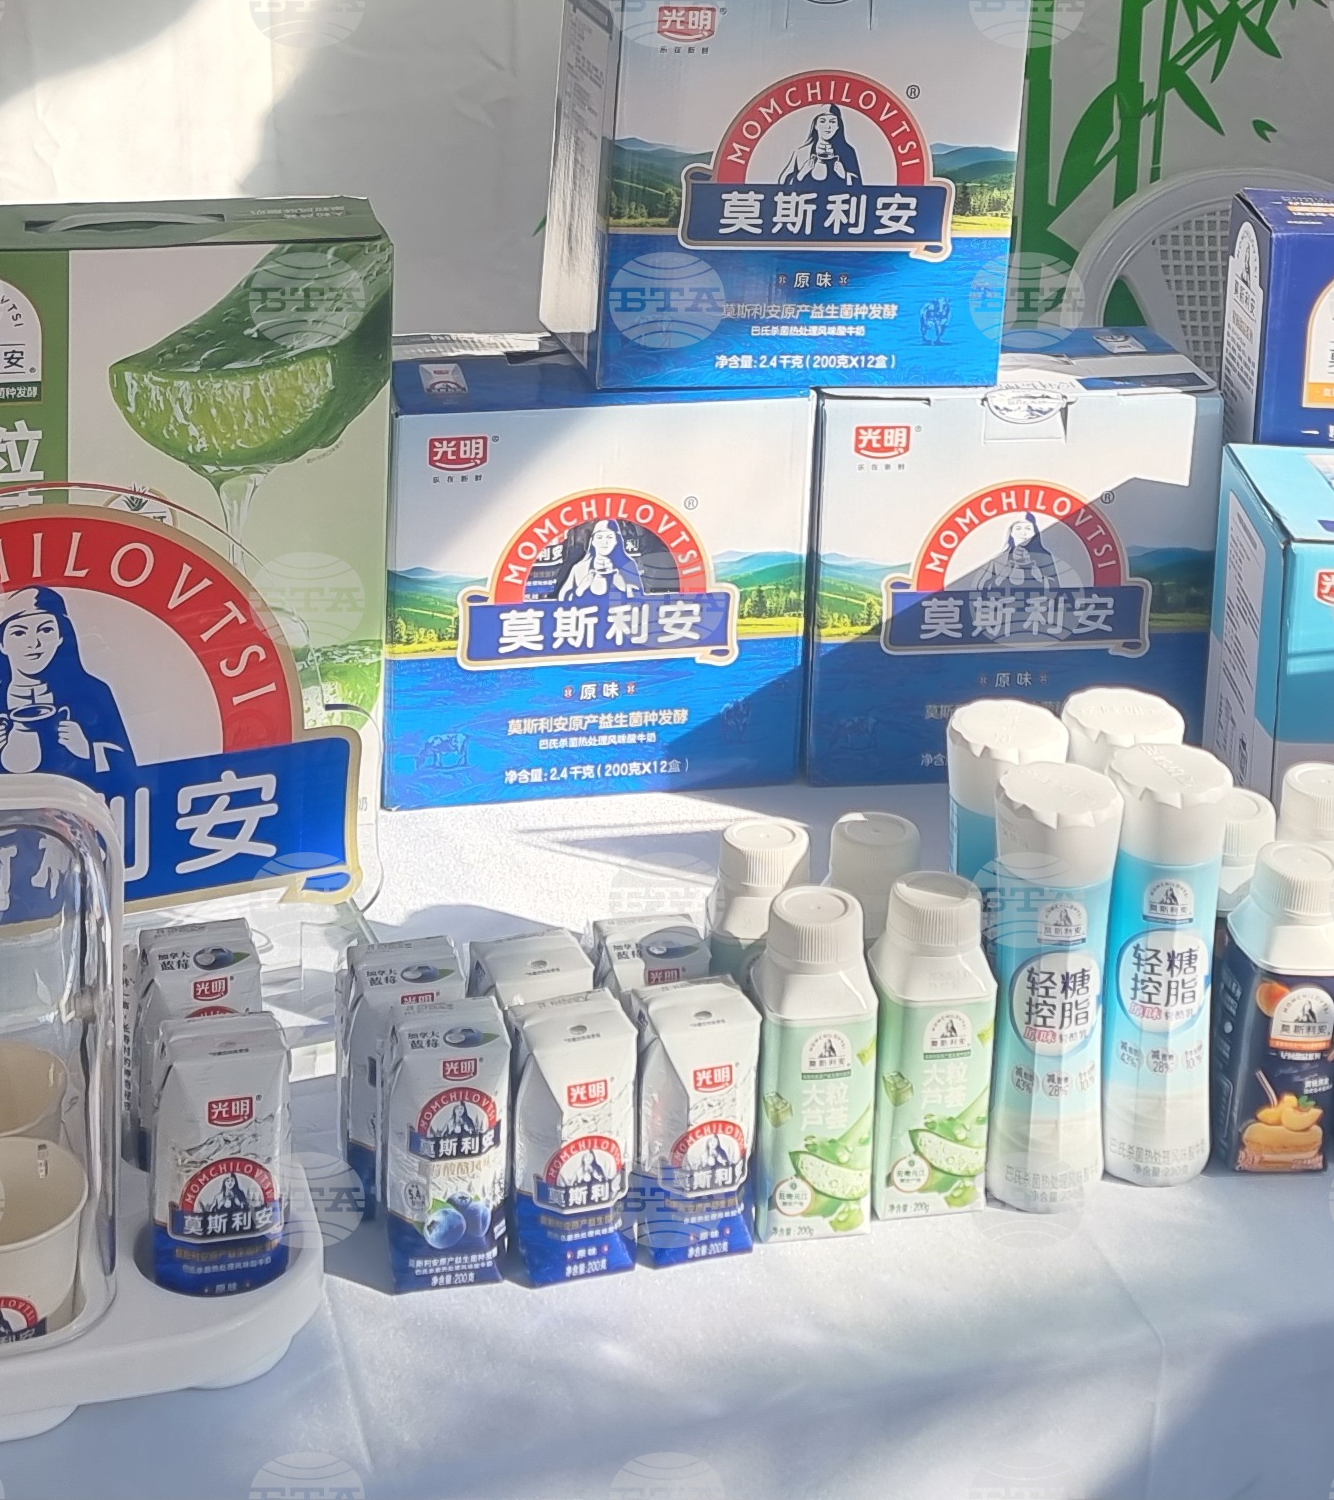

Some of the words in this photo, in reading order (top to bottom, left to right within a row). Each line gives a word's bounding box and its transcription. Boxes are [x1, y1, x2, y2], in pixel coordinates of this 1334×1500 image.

[662, 9, 712, 31] 光明
[727, 80, 920, 167] MOMCHILOVTSI
[718, 190, 919, 235] 莫斯利安
[794, 272, 832, 288] 原味
[722, 303, 899, 320] 莫斯利安原产益生菌种发酵
[433, 438, 484, 460] 光明
[858, 428, 908, 449] 光明
[503, 497, 702, 585] MOMCHILOVTSI
[925, 486, 1117, 574] MOMCHILOVTSI
[499, 600, 702, 654] 莫斯利安
[920, 594, 1115, 640] 莫斯利安
[580, 682, 619, 700] 原味
[995, 672, 1032, 688] 原味
[507, 708, 689, 736] 莫斯利安原产益生菌种发酵
[921, 753, 948, 767] 净含
[1132, 943, 1199, 979] 轻糖
[195, 980, 226, 996] 光明
[650, 970, 678, 984] 光明
[1026, 967, 1091, 1000] 轻糖
[1130, 972, 1198, 1008] 控脂
[1024, 996, 1090, 1030] 控脂
[445, 1059, 475, 1076] 光明
[696, 1067, 731, 1087] 光明
[923, 1062, 968, 1087] 大粒
[570, 1081, 606, 1103] 光明
[801, 1081, 850, 1107] 大粒
[211, 1100, 250, 1119] 光明
[801, 1106, 849, 1132] 芦荟
[420, 1128, 495, 1158] 莫斯利安
[183, 1208, 275, 1236] 莫斯利安
